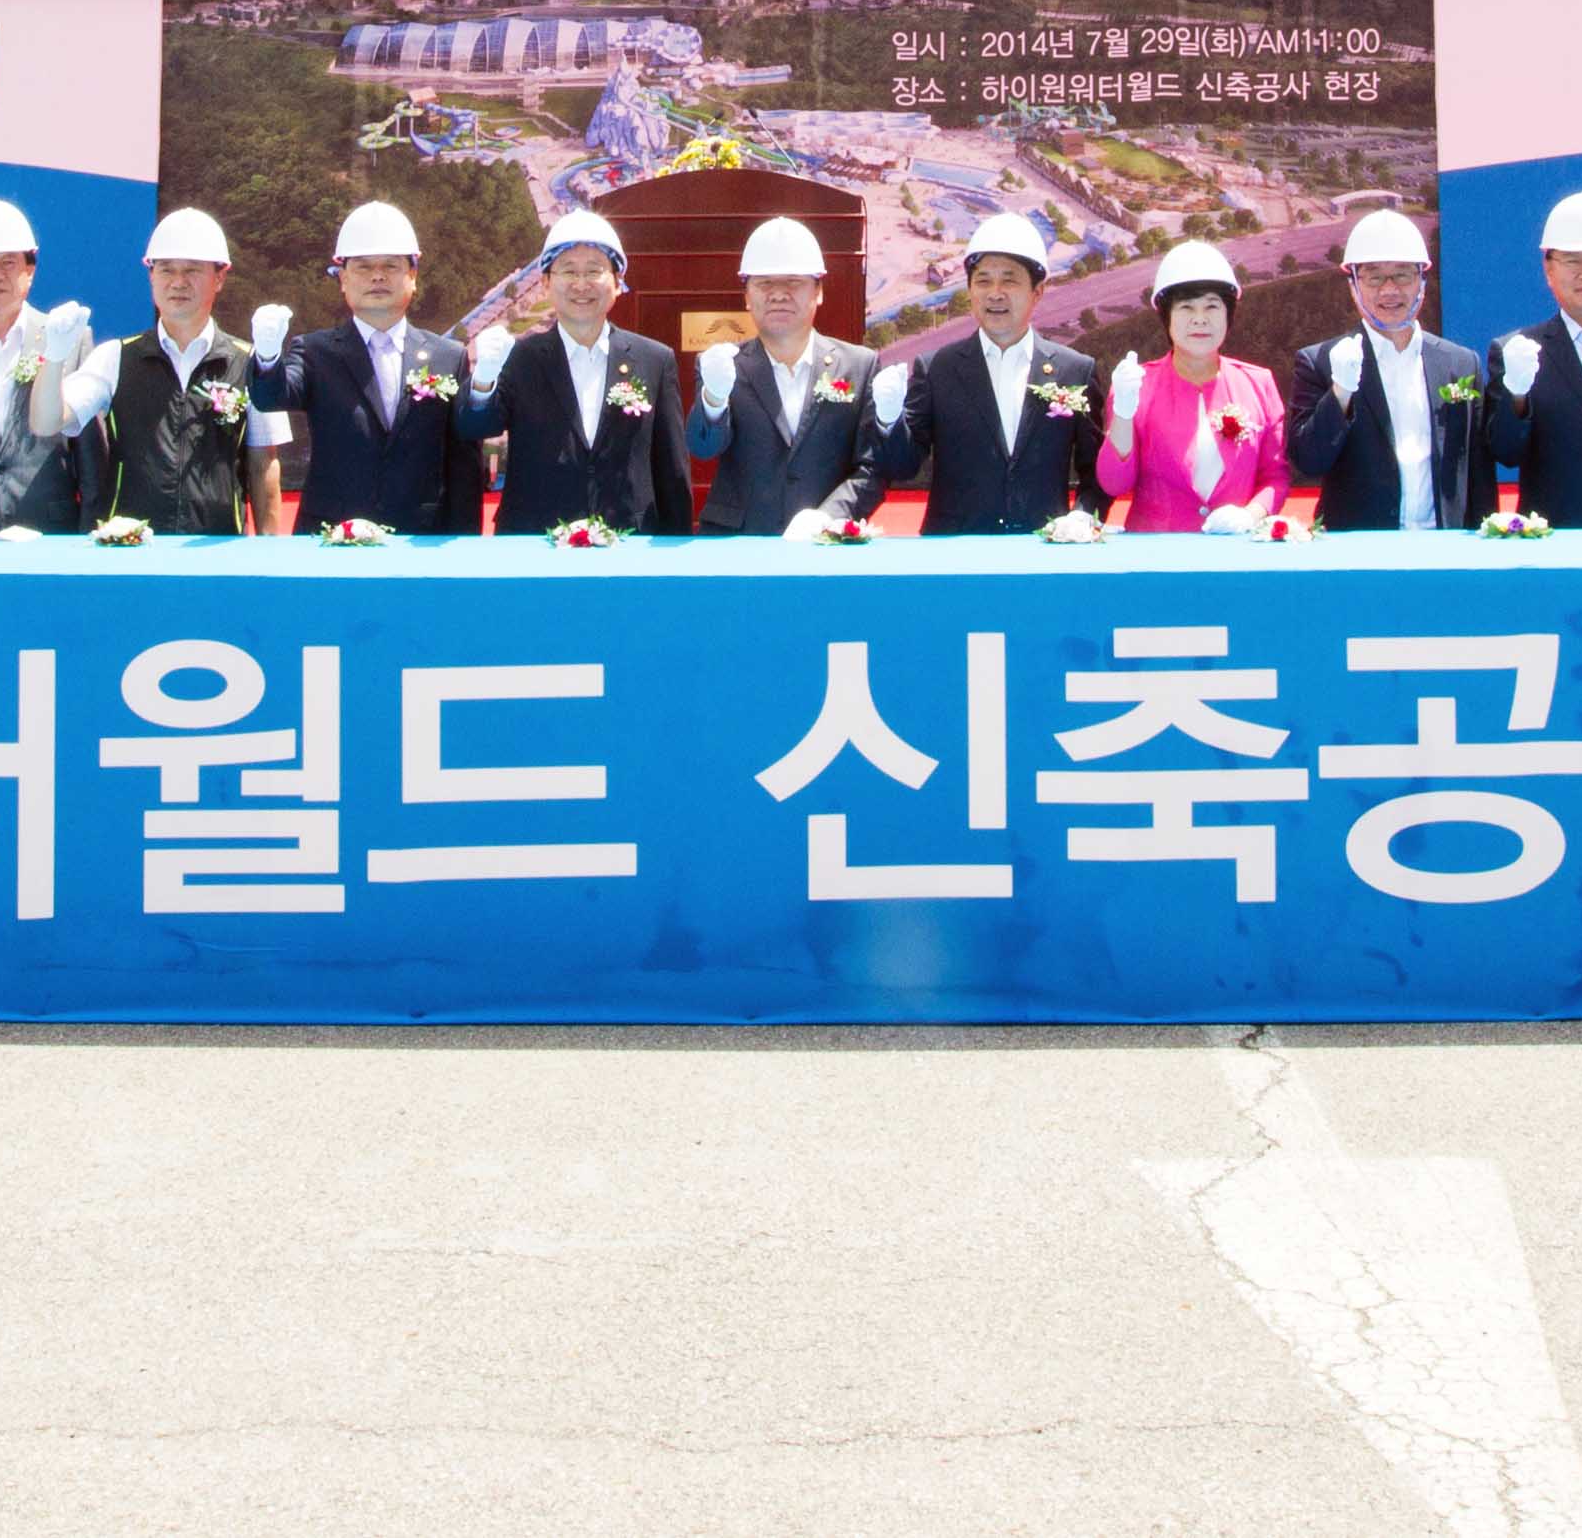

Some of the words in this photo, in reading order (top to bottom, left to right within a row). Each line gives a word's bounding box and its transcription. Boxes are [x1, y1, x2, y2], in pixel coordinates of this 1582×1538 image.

[893, 33, 943, 59] 일시
[982, 31, 1072, 57] 2014년
[1088, 29, 1127, 57] 7월
[1142, 28, 1246, 57] 29일(화)
[1257, 29, 1379, 54] AM11:00
[893, 77, 944, 105] 장소
[983, 73, 1181, 103] 하이원워터월드
[1197, 73, 1309, 101] 신축공사
[1326, 72, 1379, 100] 현장
